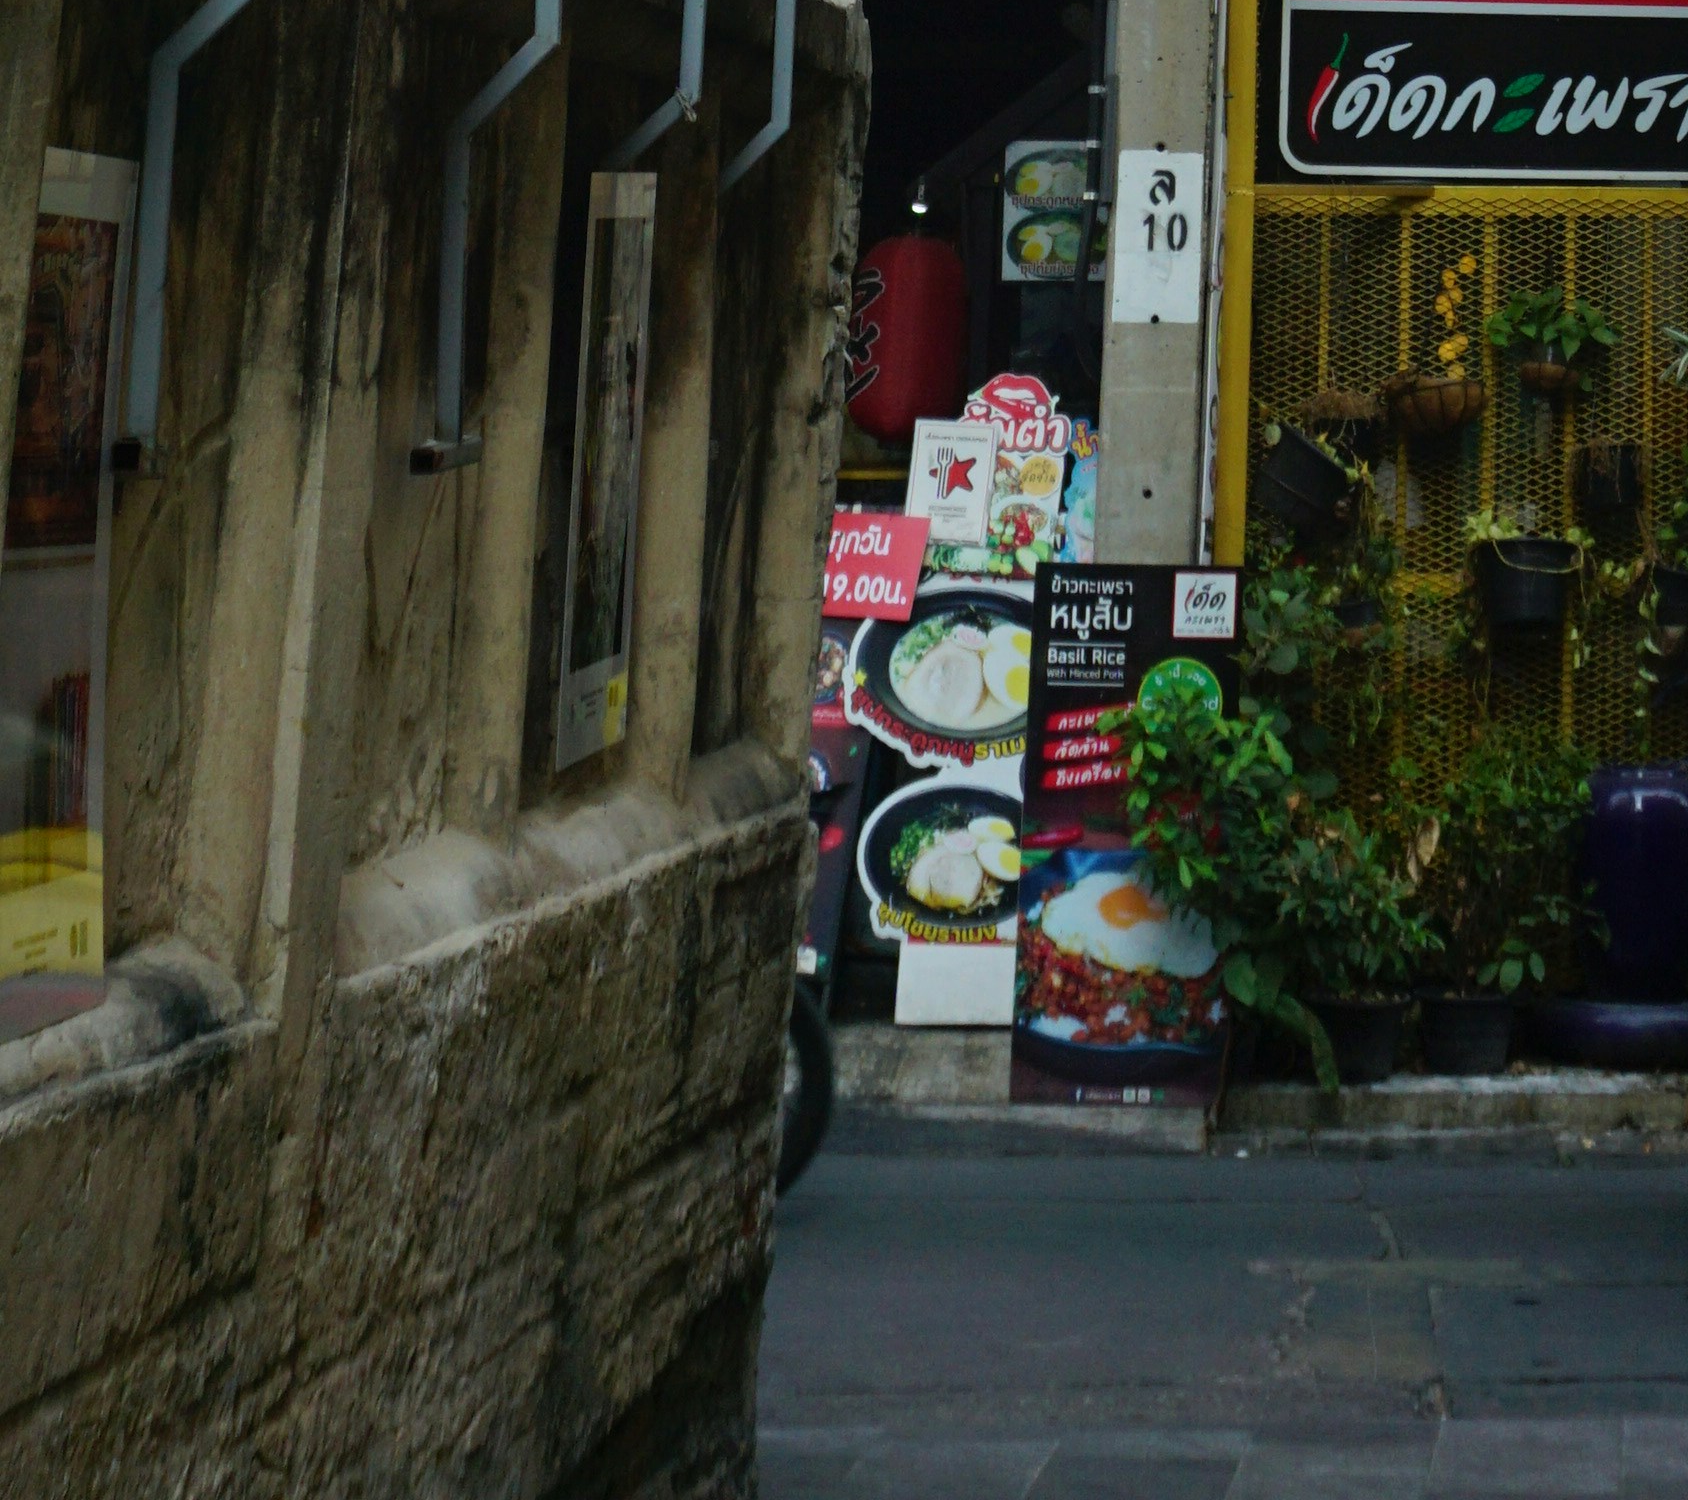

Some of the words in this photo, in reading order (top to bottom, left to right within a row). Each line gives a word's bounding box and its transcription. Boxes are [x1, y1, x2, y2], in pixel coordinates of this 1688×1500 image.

[1149, 168, 1176, 206] ล
[1143, 212, 1188, 252] 10
[1051, 573, 1133, 595] ข้าวกะเพรา
[1050, 597, 1133, 641] หมูสับ
[1047, 647, 1086, 665] Basil
[1092, 648, 1126, 666] Rice
